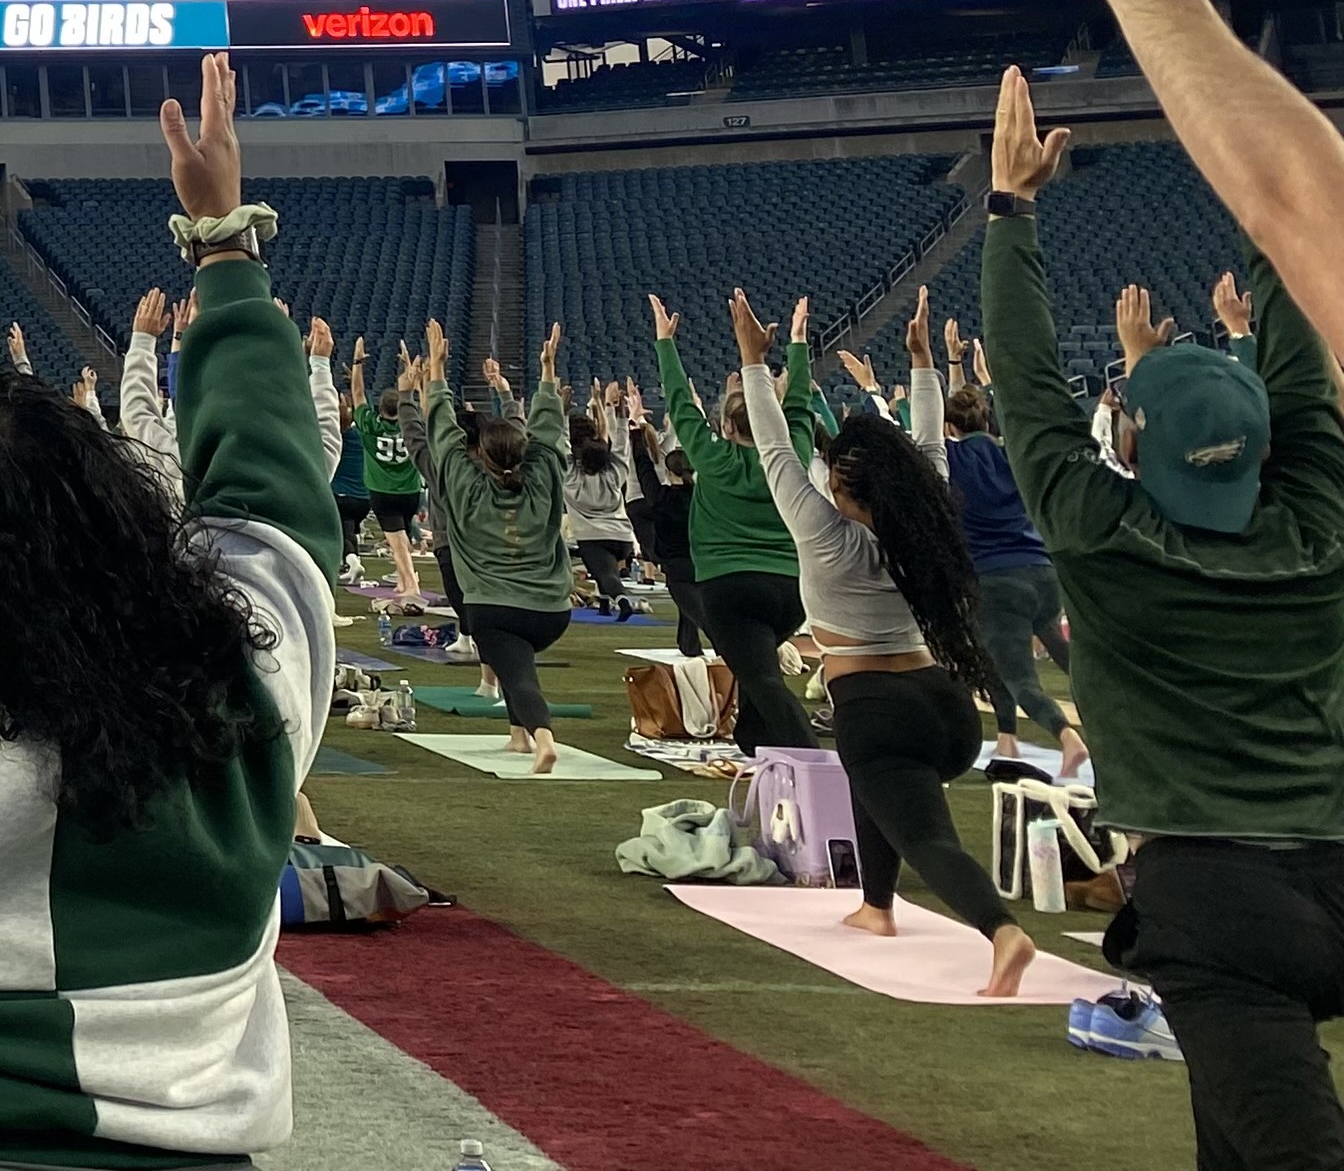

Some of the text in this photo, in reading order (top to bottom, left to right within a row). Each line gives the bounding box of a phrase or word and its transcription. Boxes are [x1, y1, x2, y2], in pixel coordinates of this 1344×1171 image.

[3, 2, 175, 47] GO BIRDS
[302, 6, 434, 38] verizon
[727, 117, 746, 126] 127
